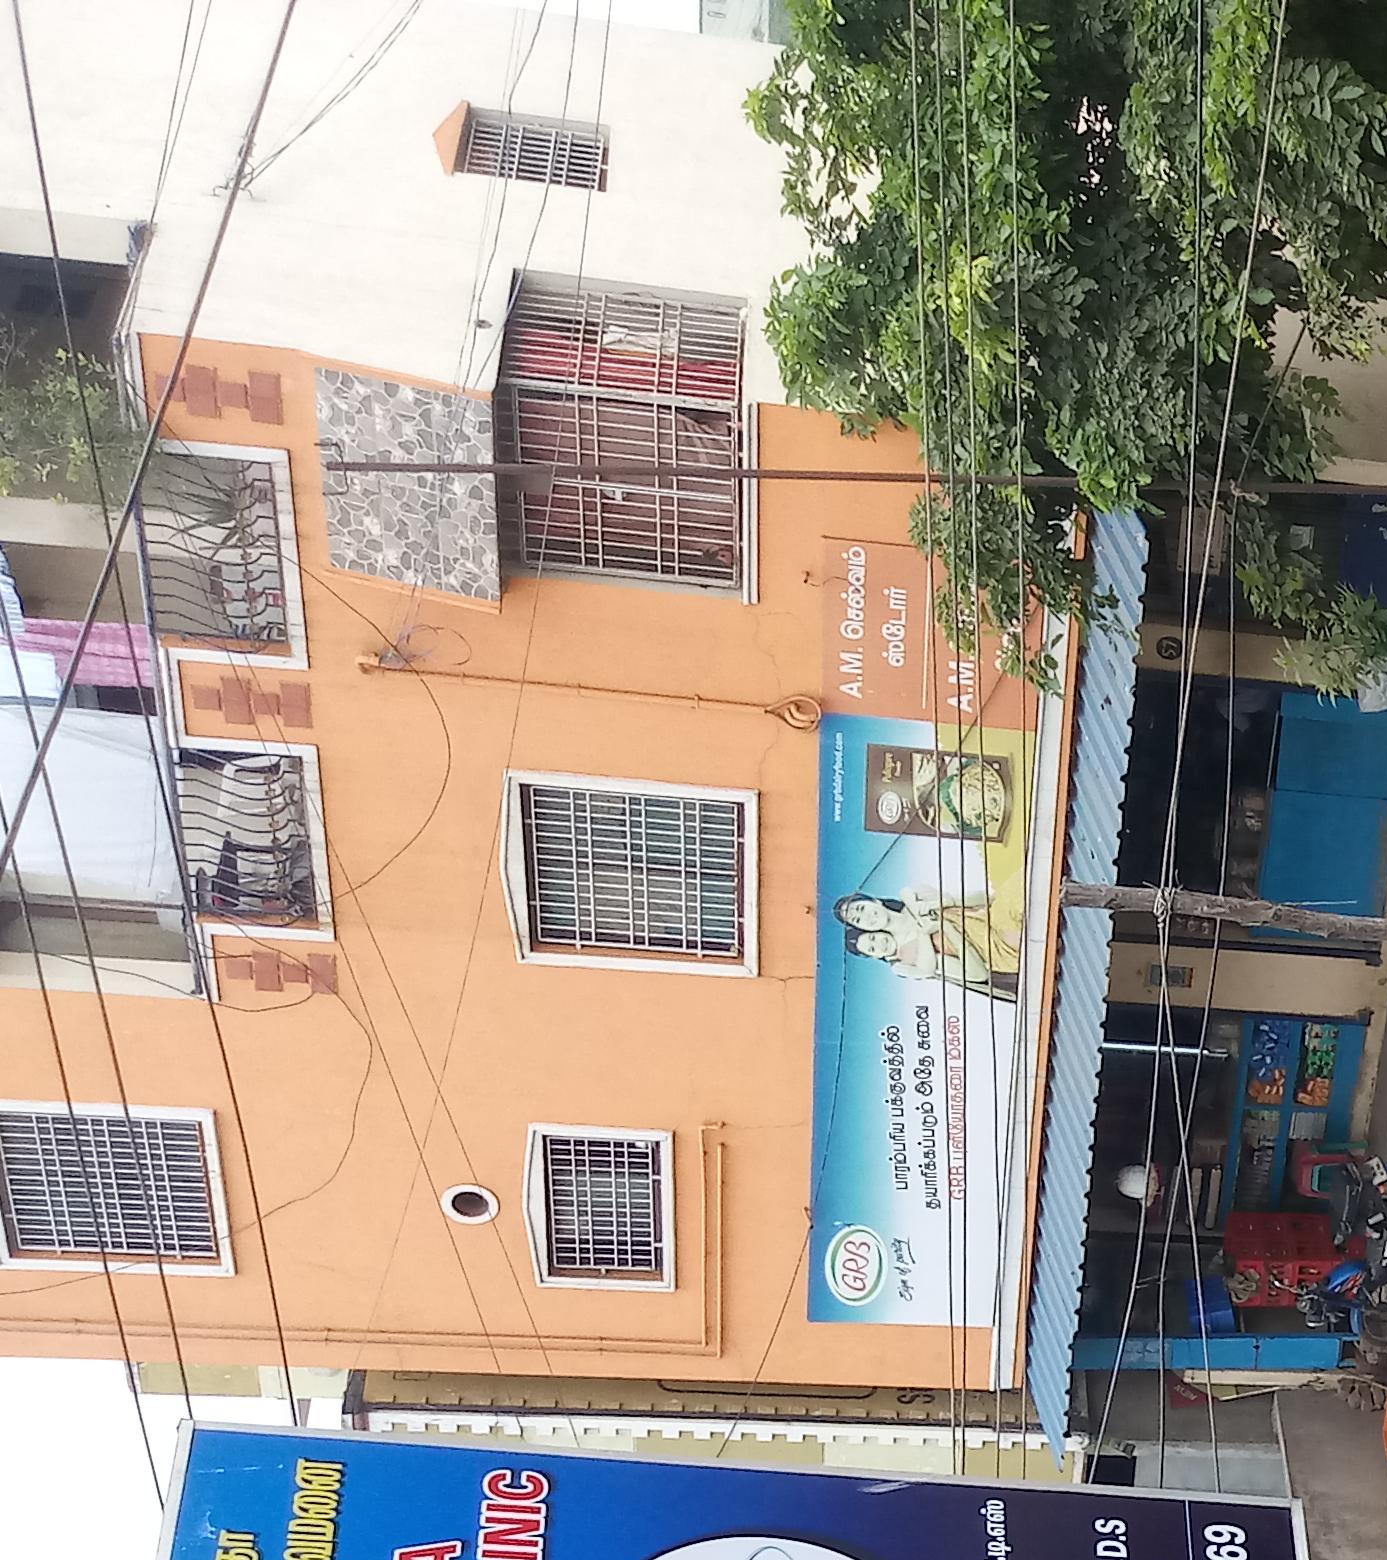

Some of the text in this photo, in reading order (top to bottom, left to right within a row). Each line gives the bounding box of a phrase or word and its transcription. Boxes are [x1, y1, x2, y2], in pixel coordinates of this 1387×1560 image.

[839, 546, 865, 699] A.M. செல்வம்
[882, 586, 907, 667] ஸ்டோர்
[880, 1025, 911, 1190] பாரம்பரிய பக்குவத்தில்
[911, 1005, 941, 1209] தயாரிக்கப்படும் அதே சுவை
[841, 1242, 870, 1292] GRB
